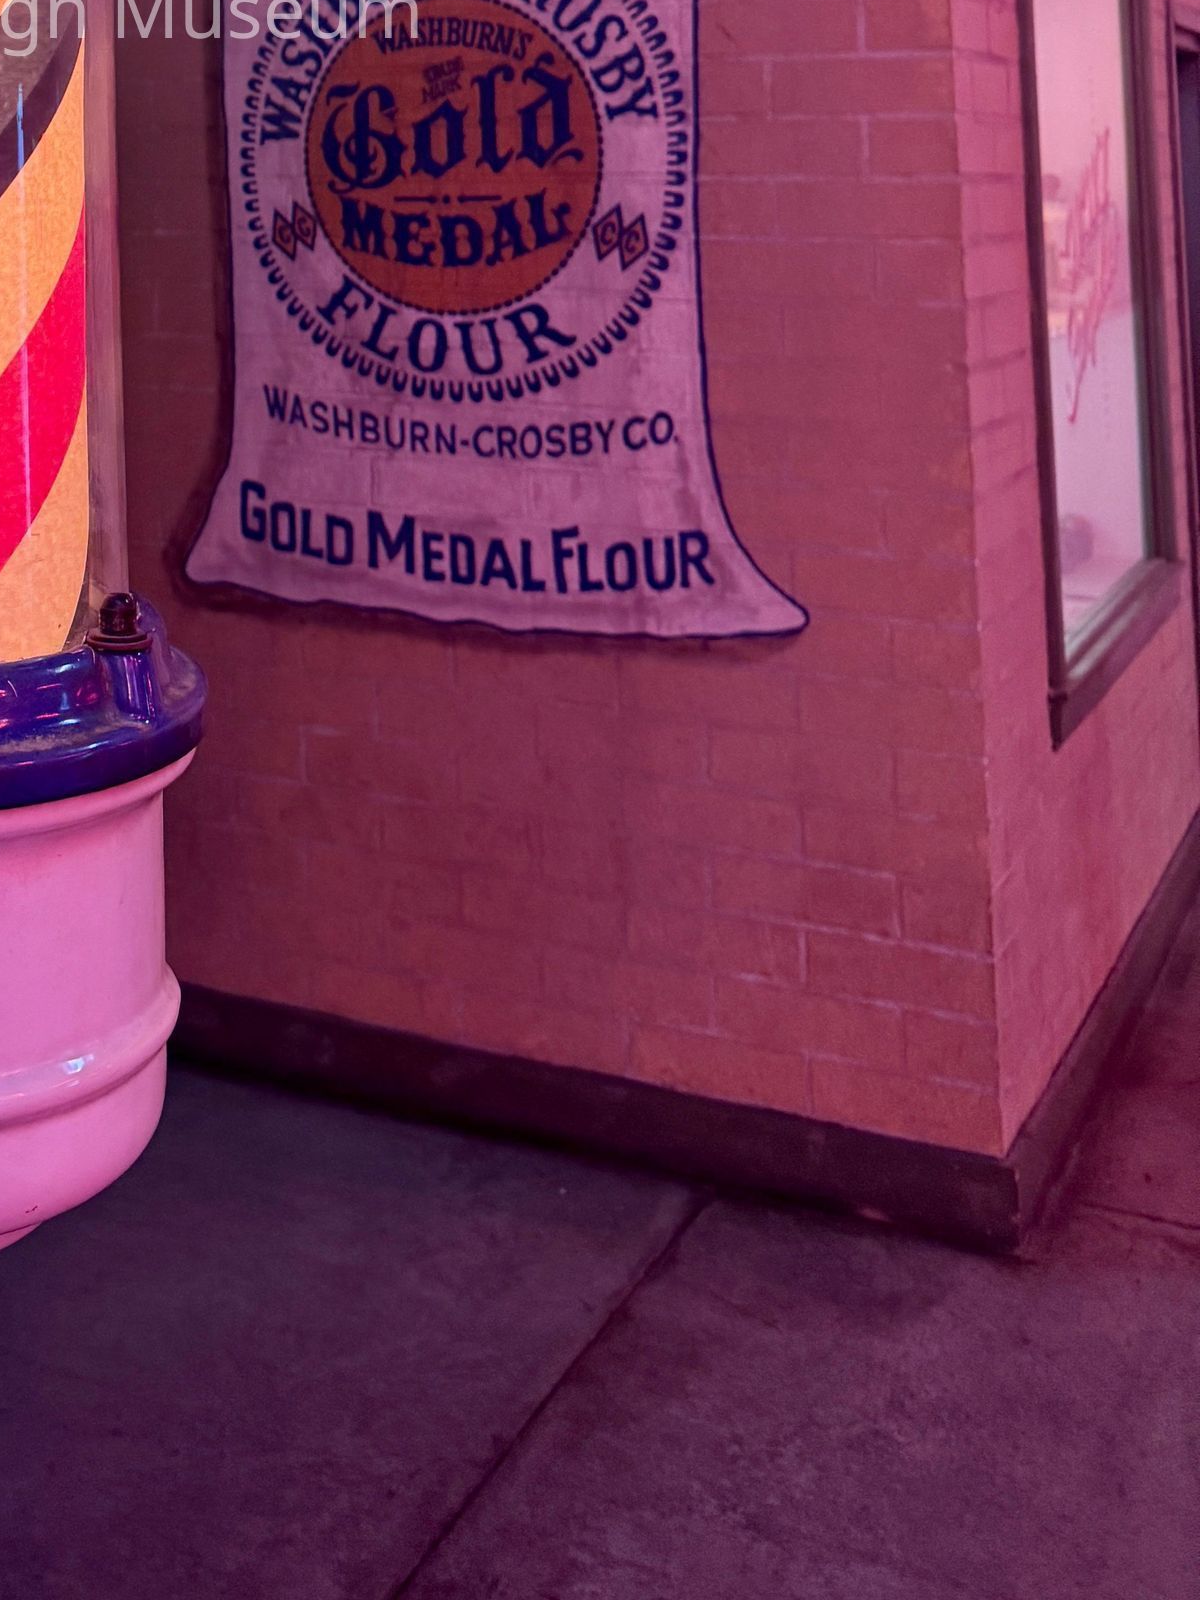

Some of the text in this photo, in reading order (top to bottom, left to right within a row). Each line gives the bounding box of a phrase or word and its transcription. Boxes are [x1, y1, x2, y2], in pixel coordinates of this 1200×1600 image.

[321, 52, 585, 195] Gold
[339, 188, 573, 268] MEDAL
[316, 274, 577, 376] FLOUR
[263, 383, 616, 460] WASHBURN-CROSBY
[240, 479, 716, 594] GOLD MEDAL FLOUR
